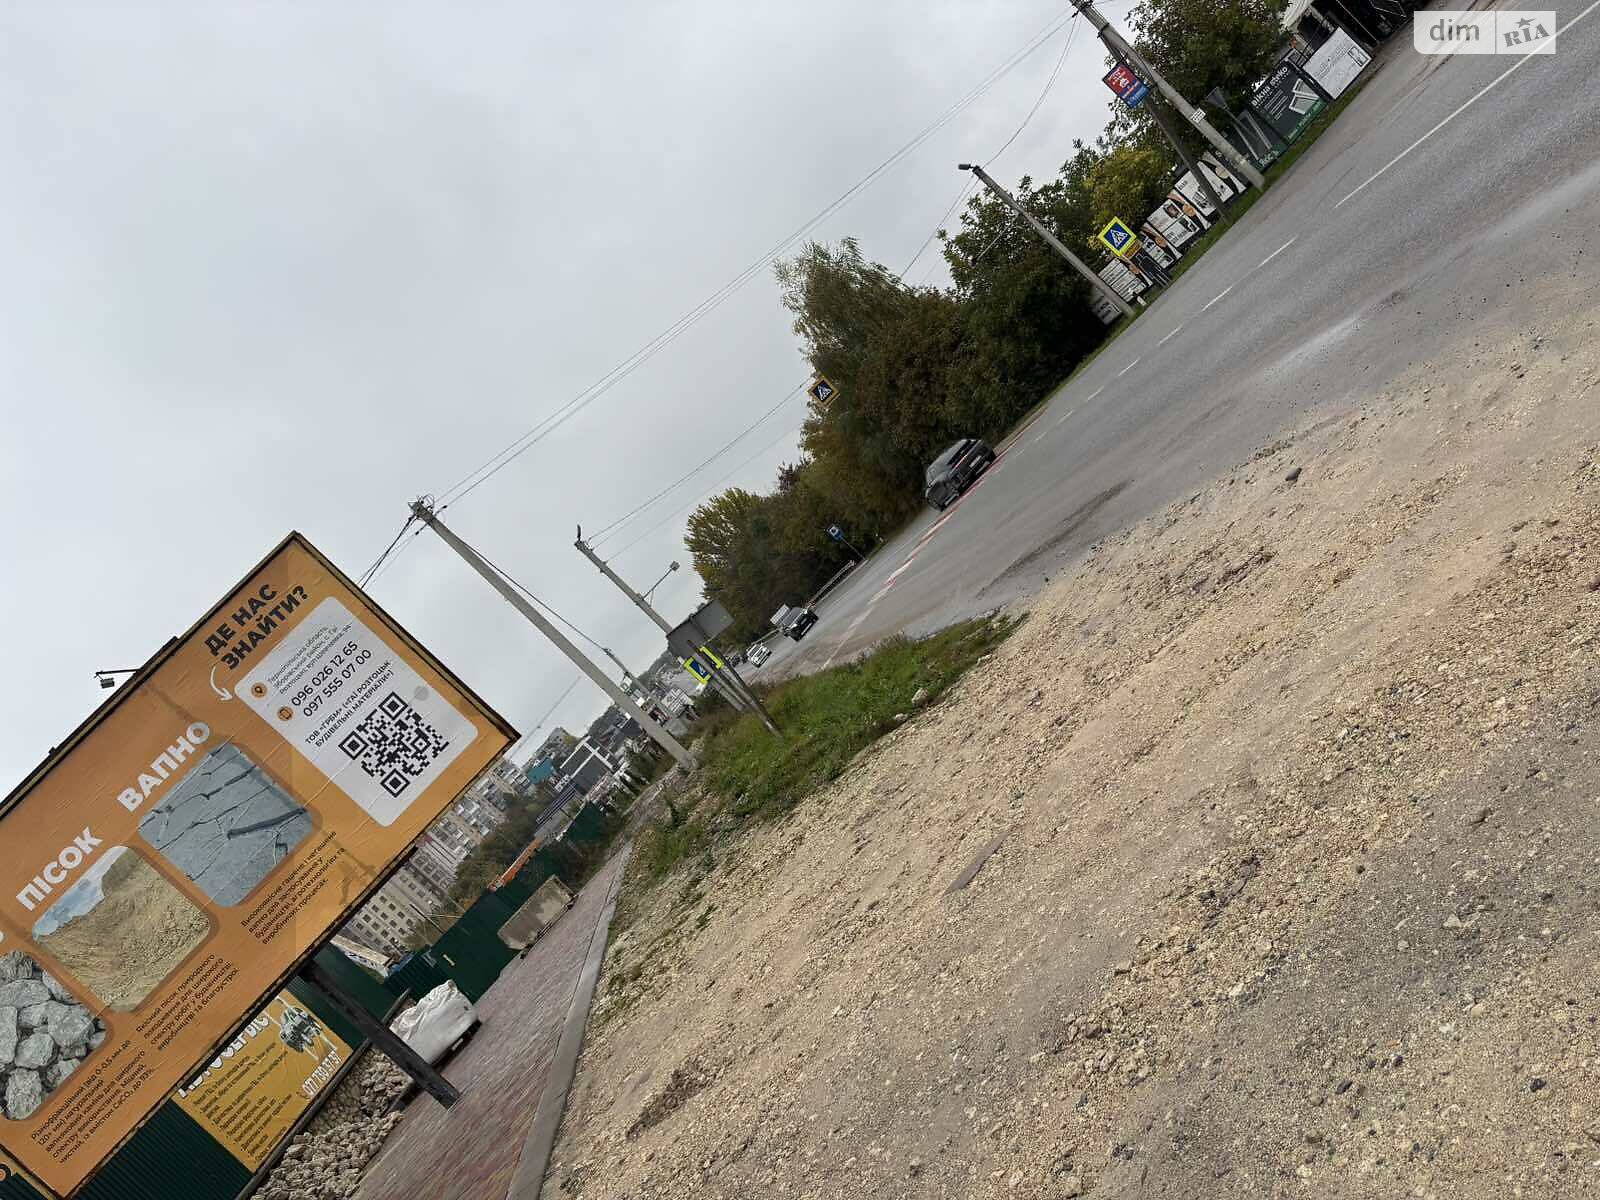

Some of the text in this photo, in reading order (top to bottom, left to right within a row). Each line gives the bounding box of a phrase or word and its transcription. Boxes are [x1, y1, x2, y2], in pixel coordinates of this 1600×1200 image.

[204, 583, 277, 656] ДЕ НАС
[220, 585, 308, 670] ЗНАЙТИ?
[289, 639, 358, 707] 096 026 12 65
[301, 647, 372, 717] 097 555 07 00
[304, 729, 320, 745] ТОВ
[313, 708, 354, 748] БУДІВЕЛЬНІ
[116, 721, 210, 813] ВАПНО
[15, 825, 103, 912] ПІСОК
[176, 953, 216, 992] природного
